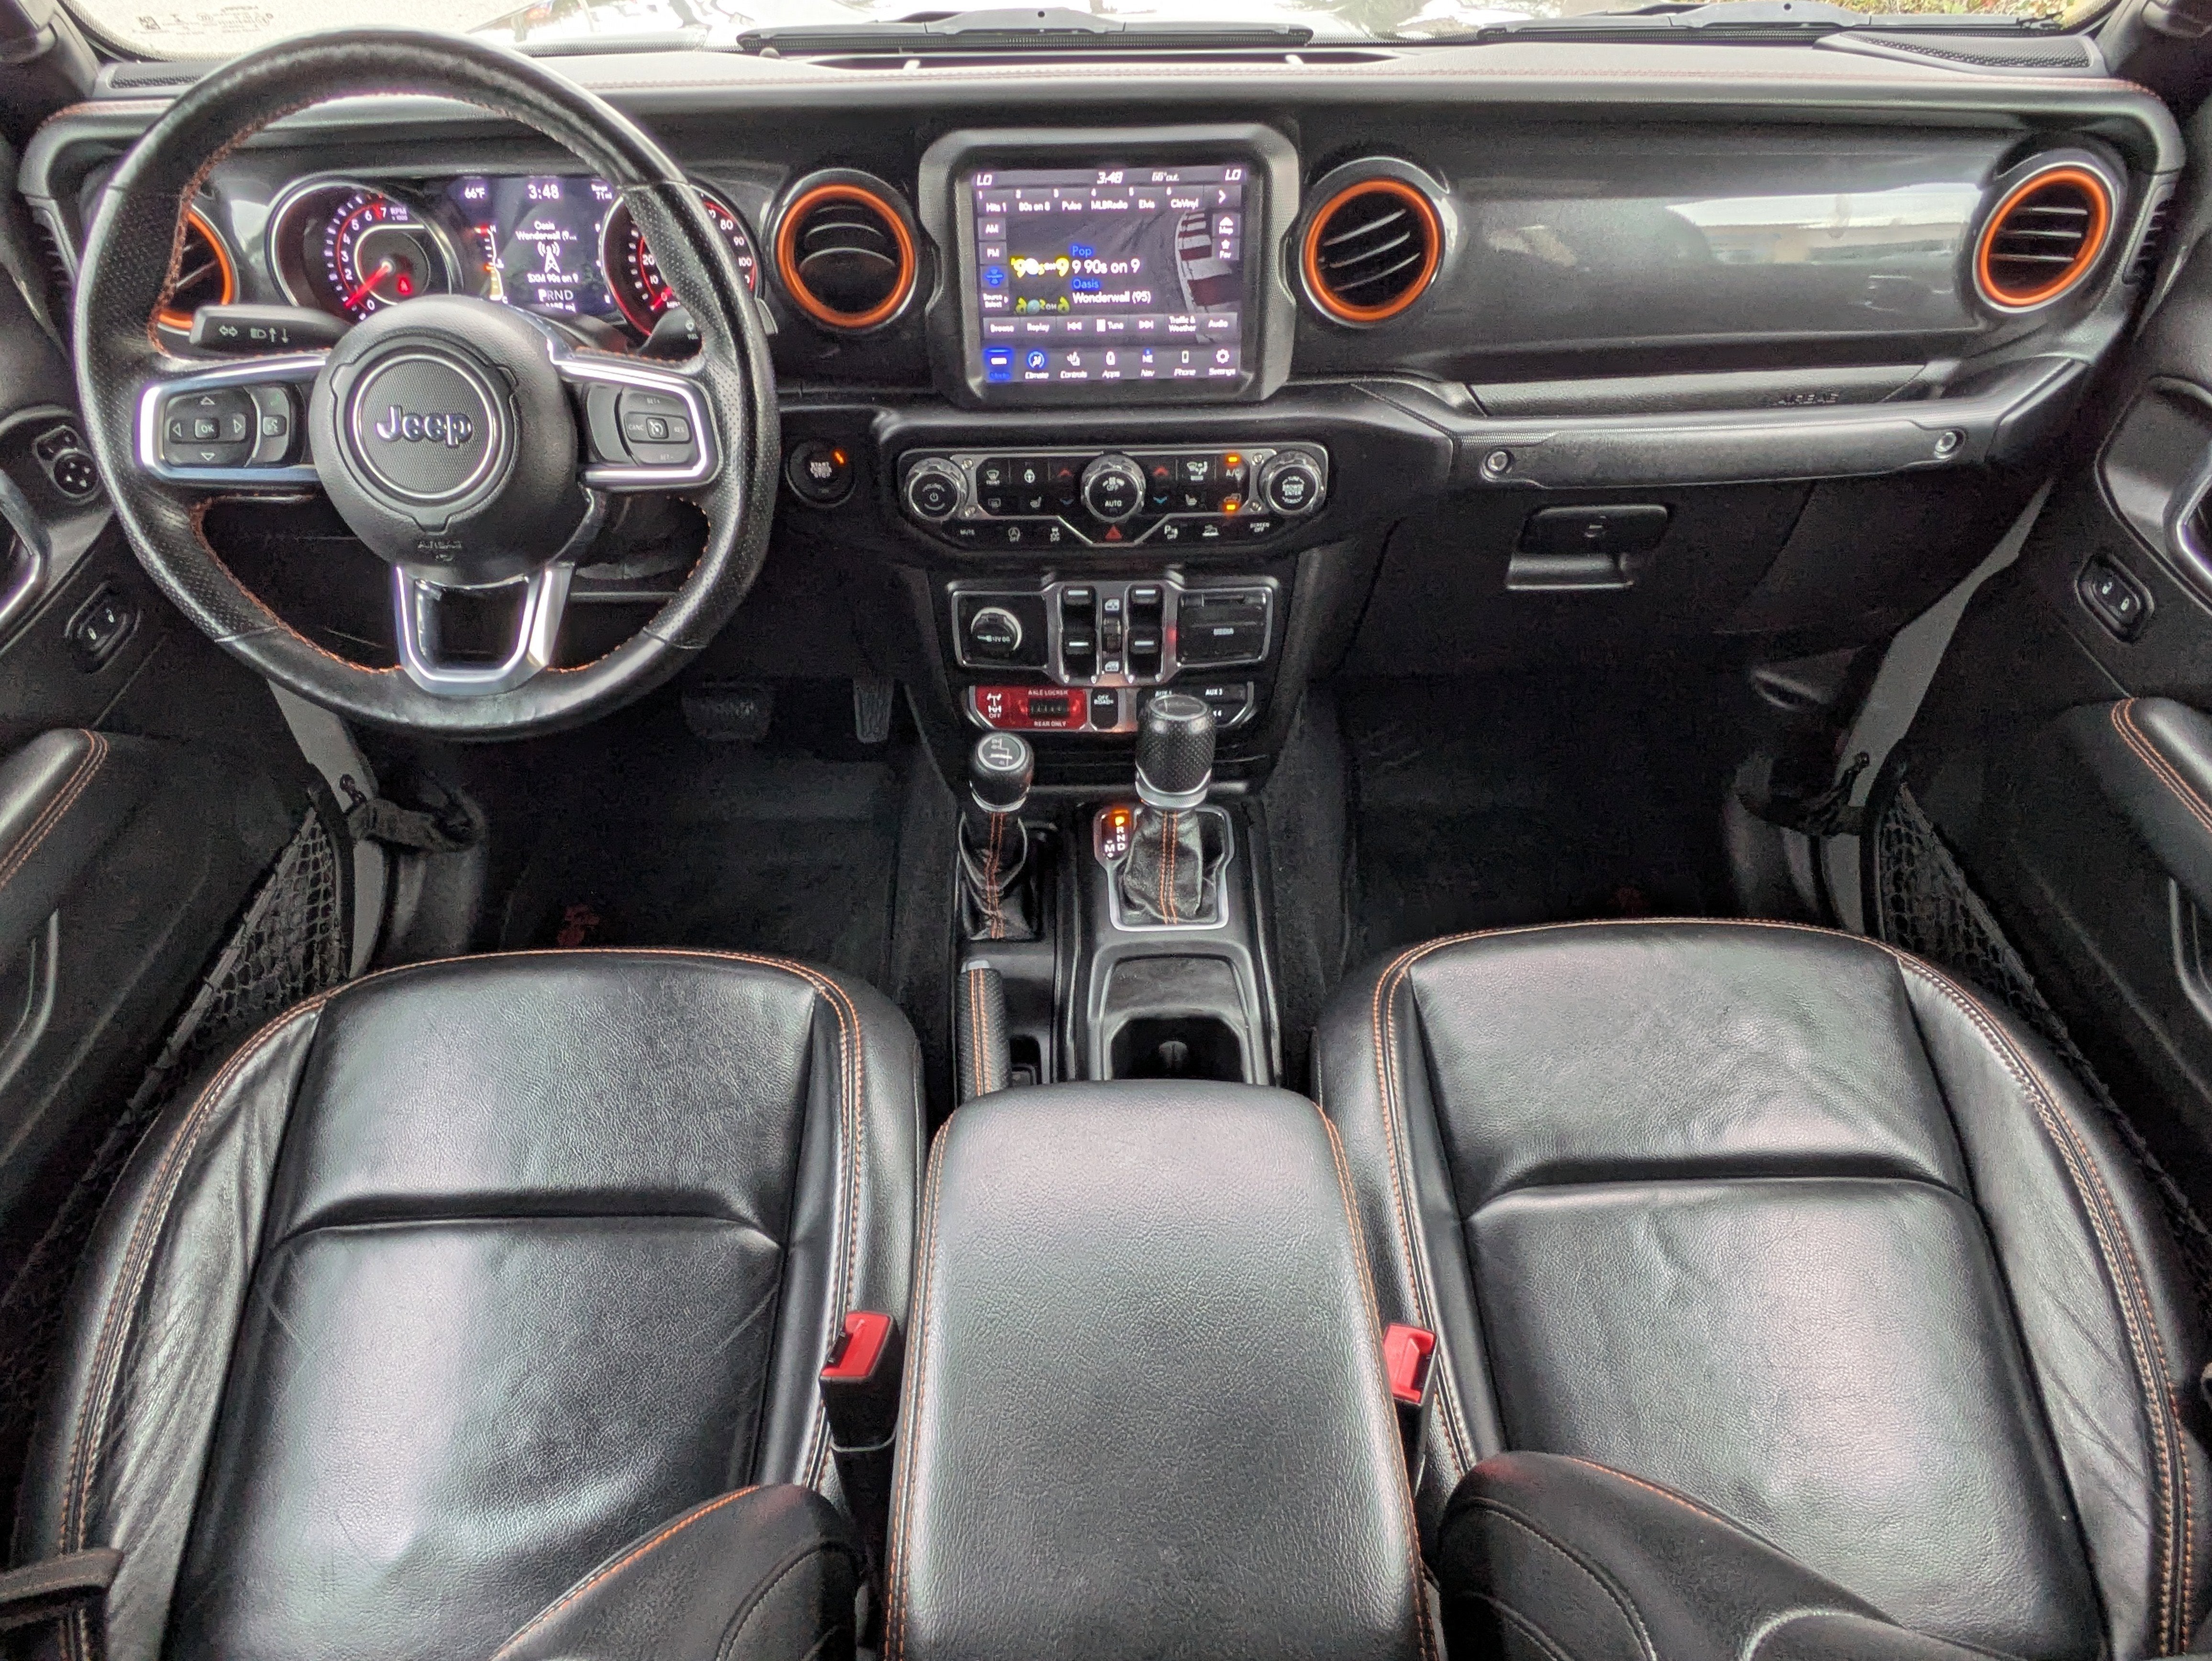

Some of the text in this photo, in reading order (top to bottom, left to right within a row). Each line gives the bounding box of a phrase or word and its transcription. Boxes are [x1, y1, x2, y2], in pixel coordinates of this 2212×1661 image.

[976, 174, 993, 186] LO
[1225, 169, 1241, 181] LO
[528, 184, 559, 199] 3:48
[365, 210, 372, 222] 6
[380, 207, 387, 218] 7
[390, 207, 407, 216] RPM
[351, 219, 359, 231] 5
[720, 219, 734, 231] 80
[985, 224, 999, 234] AM
[343, 233, 351, 244] 4
[732, 236, 745, 246] 90
[341, 250, 349, 263] 3
[986, 248, 1000, 258] FM
[1072, 245, 1093, 258] Pop
[641, 254, 655, 266] 20
[738, 256, 752, 267] 100
[1072, 258, 1140, 274] 9 90s on 9
[344, 268, 353, 281] 2
[1072, 278, 1100, 289] Oasis
[1072, 290, 1151, 304] Wonderwall (95)
[366, 299, 376, 311] 0
[201, 425, 214, 433] OK
[375, 405, 473, 448] Jeep
[1225, 468, 1240, 477] A/C
